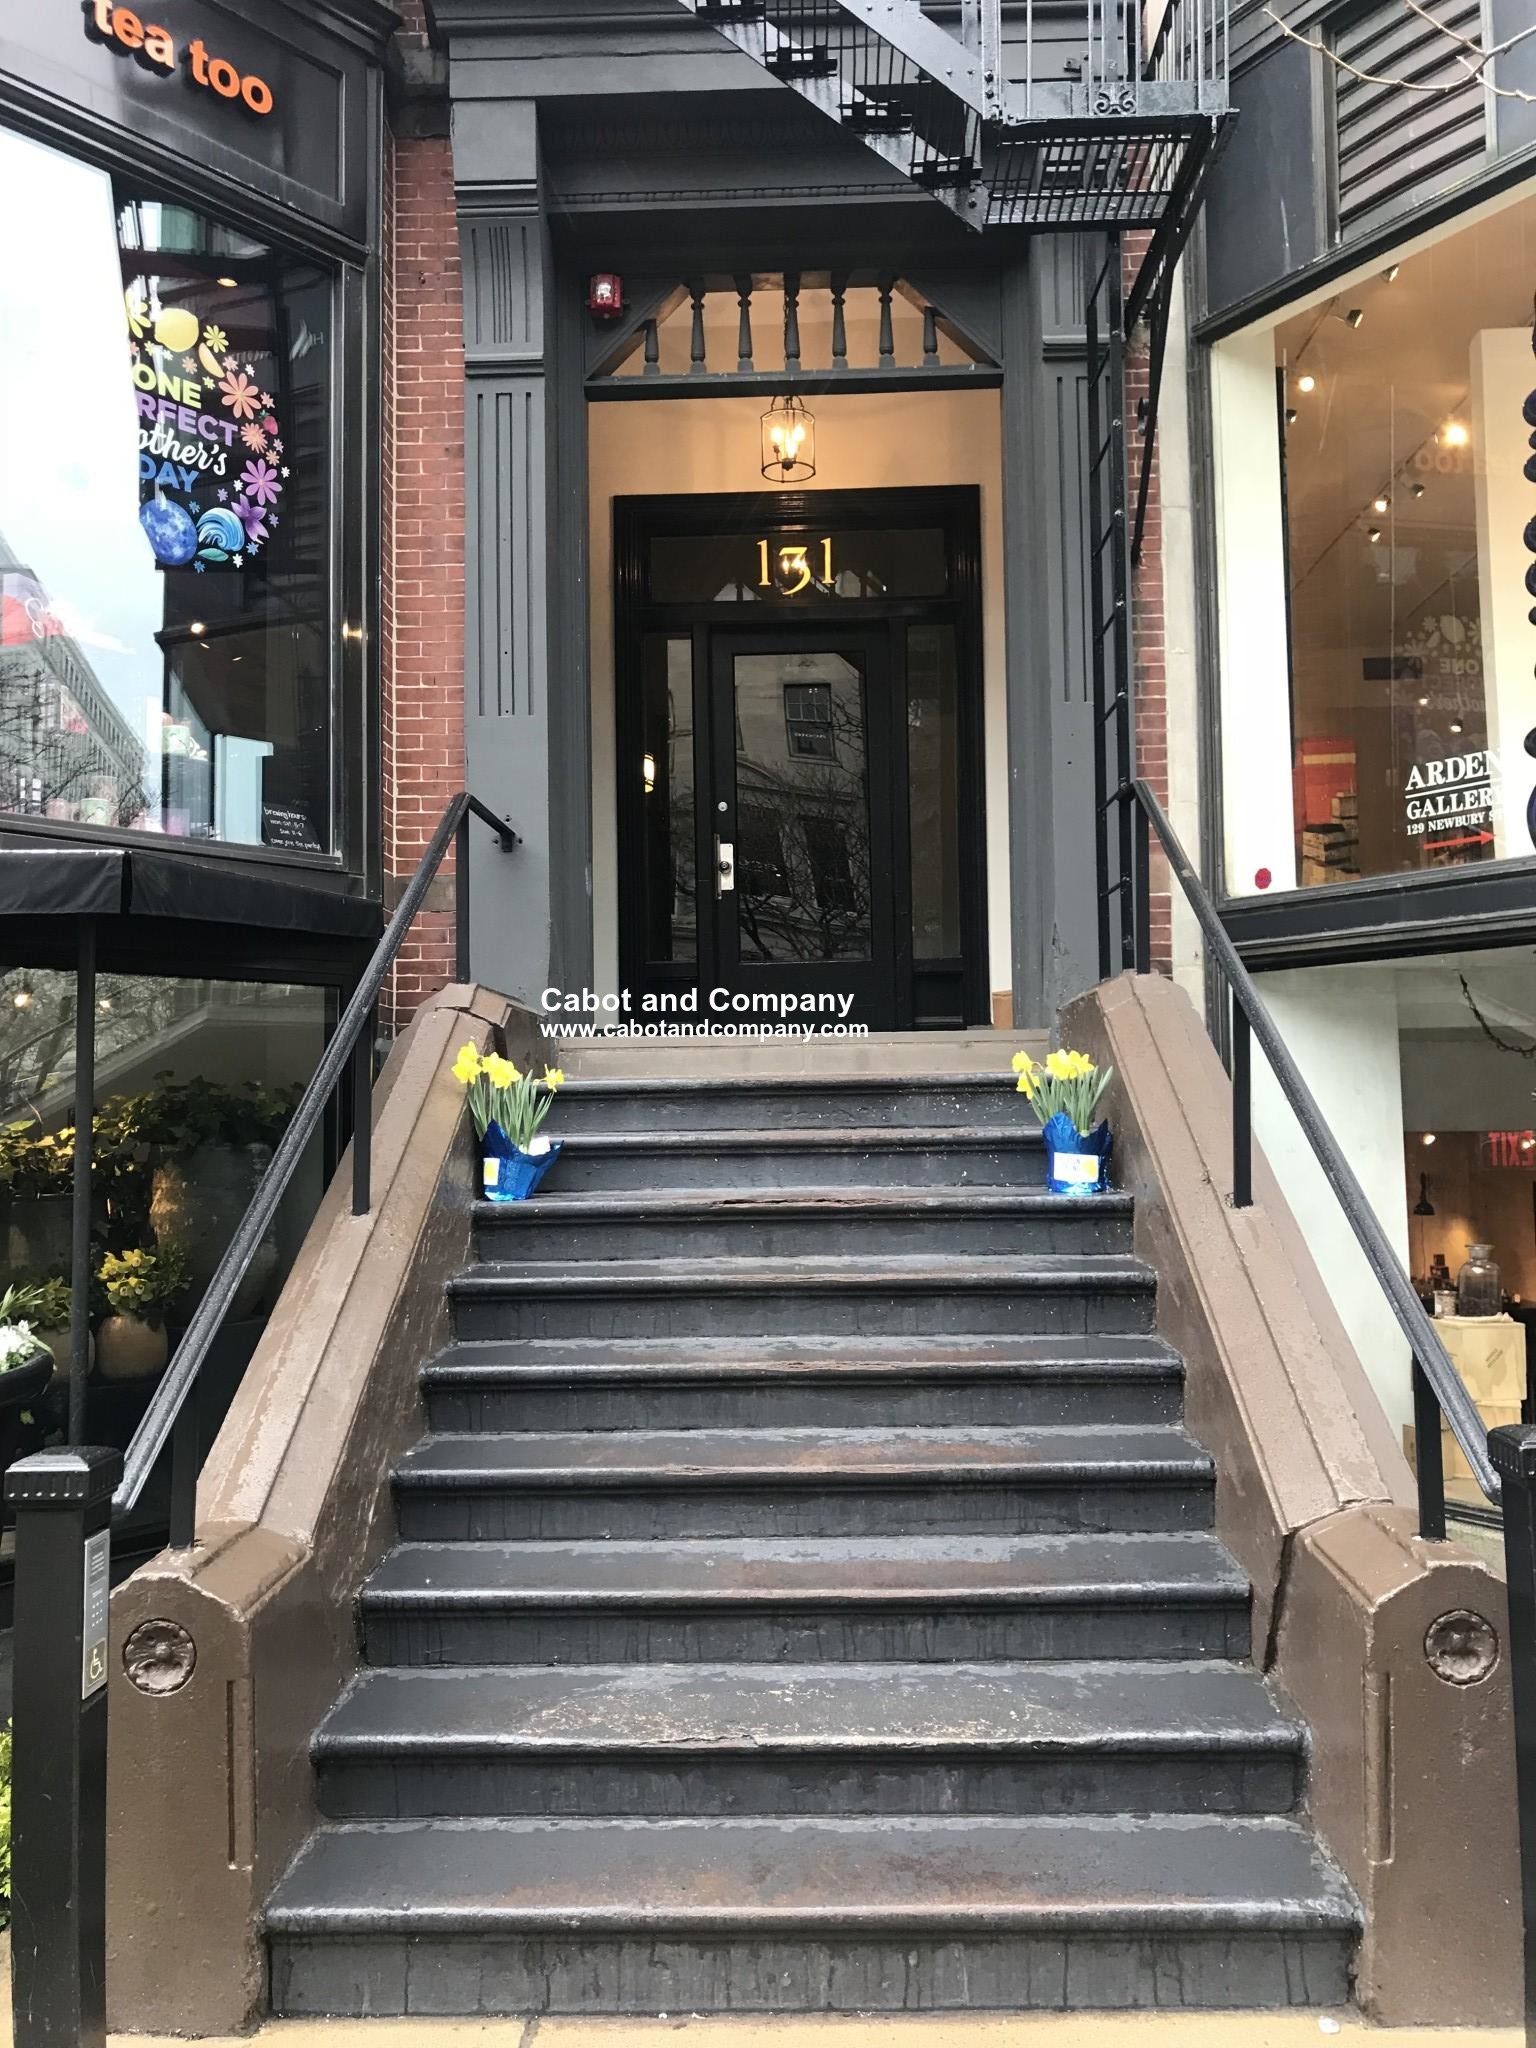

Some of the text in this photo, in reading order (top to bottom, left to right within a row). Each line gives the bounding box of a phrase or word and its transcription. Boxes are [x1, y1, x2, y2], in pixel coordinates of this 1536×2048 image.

[92, 0, 273, 114] tea too
[131, 363, 202, 409] ONE
[136, 390, 239, 447] RFECT
[138, 422, 228, 476] other's
[138, 453, 200, 493] DAY
[756, 537, 837, 595] 131
[1405, 751, 1501, 791] ARDEN
[1406, 787, 1499, 820] GALLER
[1406, 822, 1425, 836] 129
[1428, 811, 1486, 832] NEWBURY
